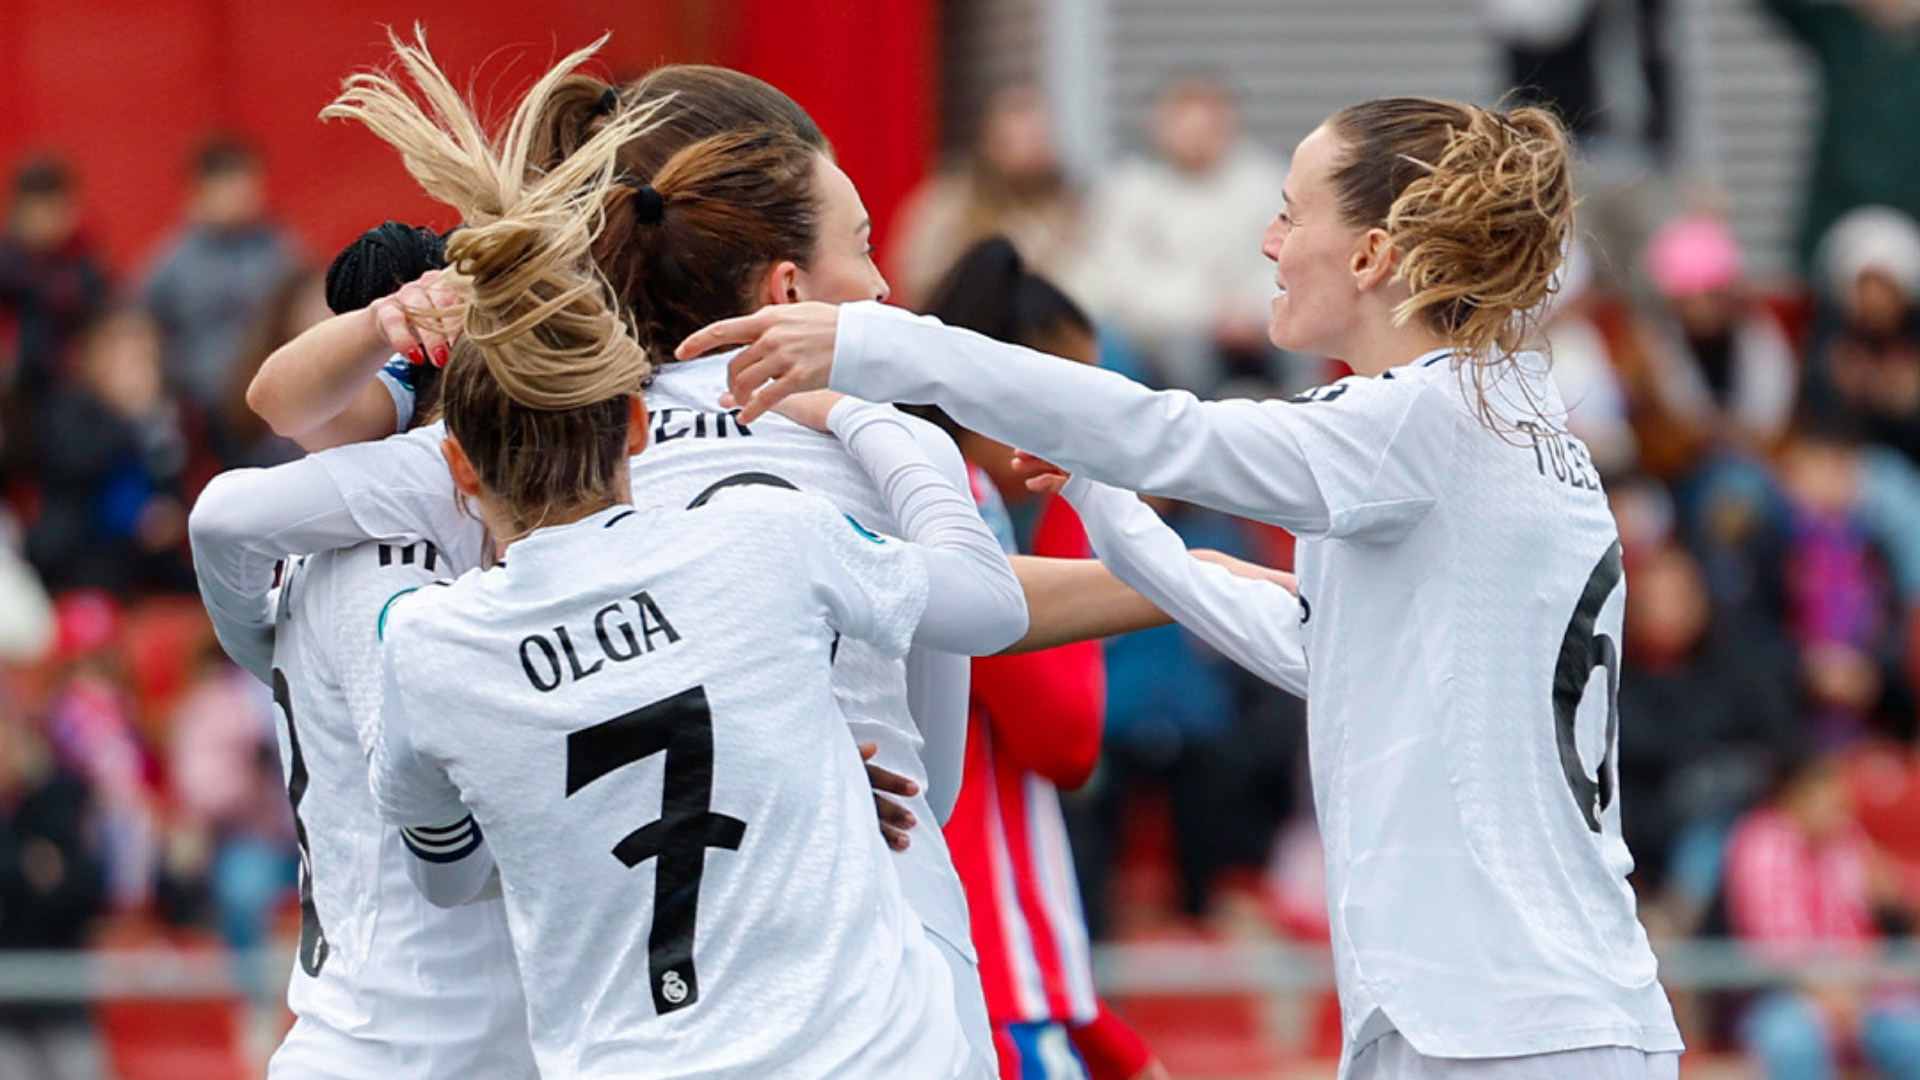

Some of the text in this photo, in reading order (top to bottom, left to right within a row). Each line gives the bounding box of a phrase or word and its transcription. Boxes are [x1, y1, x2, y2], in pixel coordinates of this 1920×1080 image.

[648, 408, 753, 444] EIR
[518, 590, 682, 693] OLGA
[1552, 537, 1620, 834] 6
[565, 684, 748, 1015] 7
